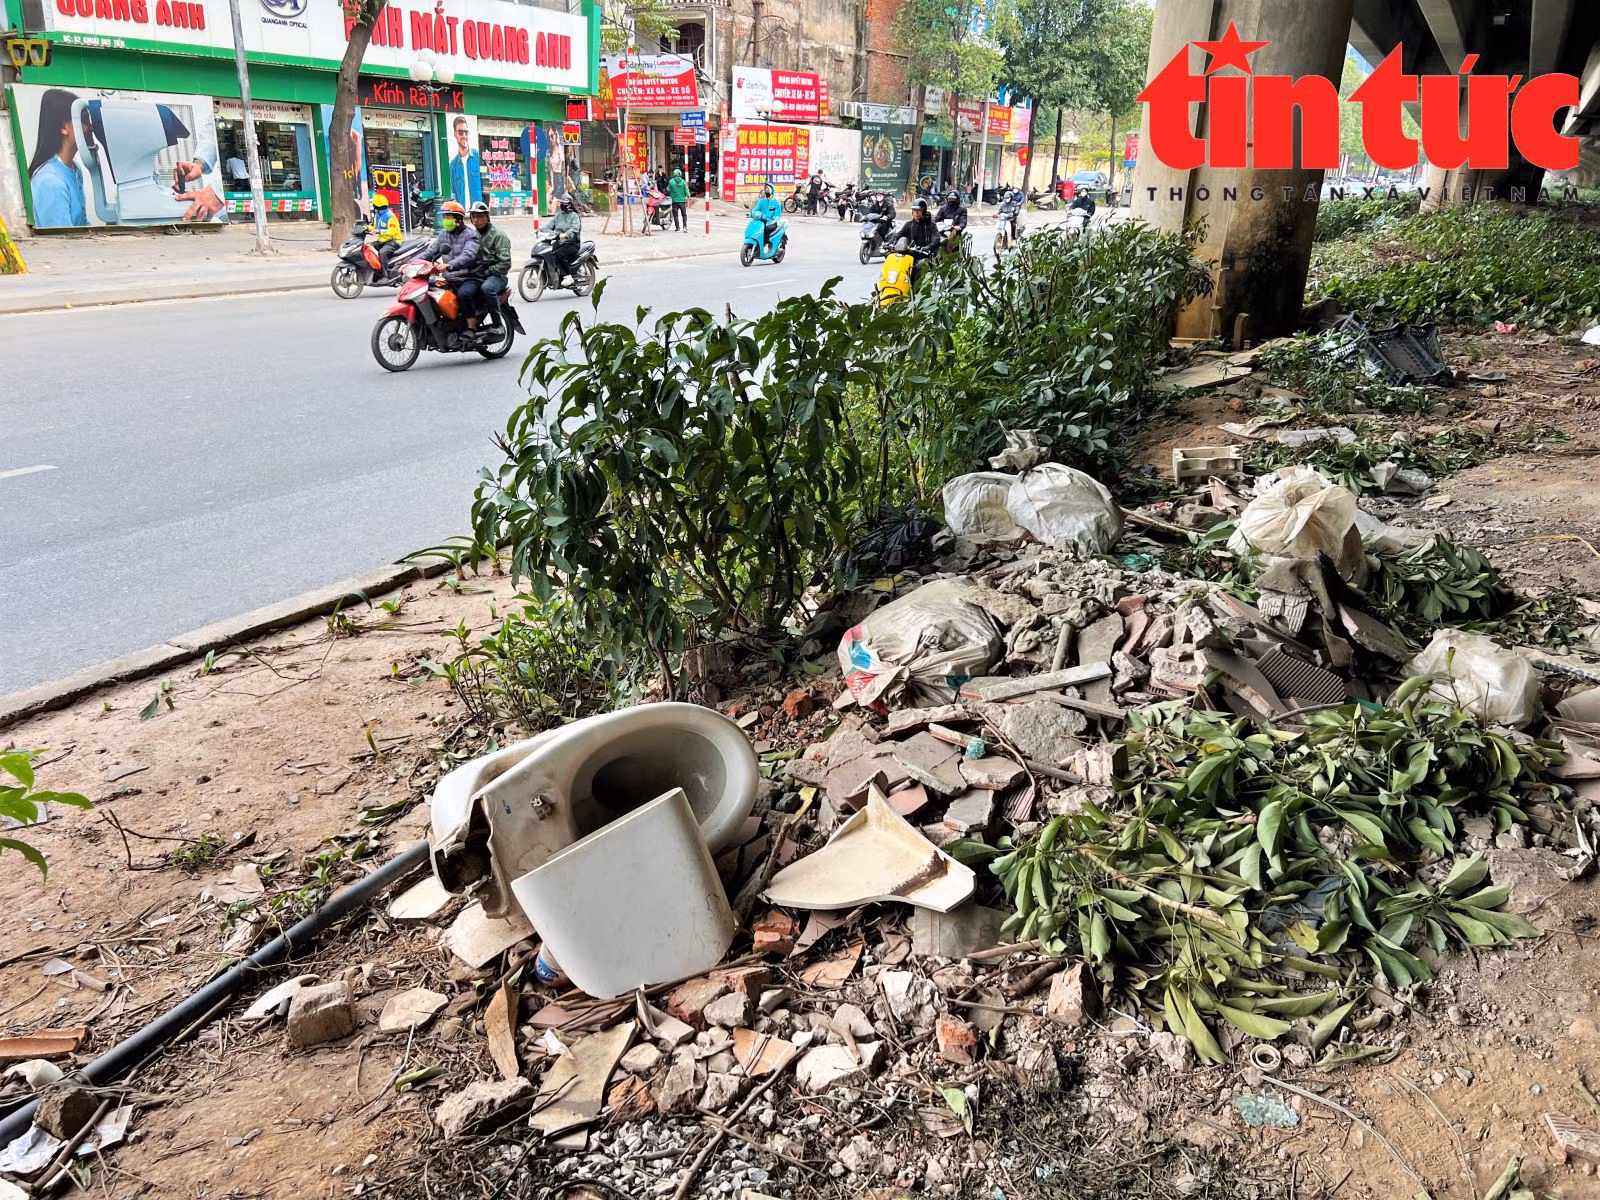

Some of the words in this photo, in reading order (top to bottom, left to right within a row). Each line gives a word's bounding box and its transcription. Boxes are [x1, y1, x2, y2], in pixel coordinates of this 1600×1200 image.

[56, 0, 149, 24] QUANG
[156, 0, 206, 31] ANH
[289, 20, 308, 29] OPTICAL
[410, 0, 459, 56] MẮT
[463, 19, 530, 65] QUANG
[535, 31, 572, 71] ANH
